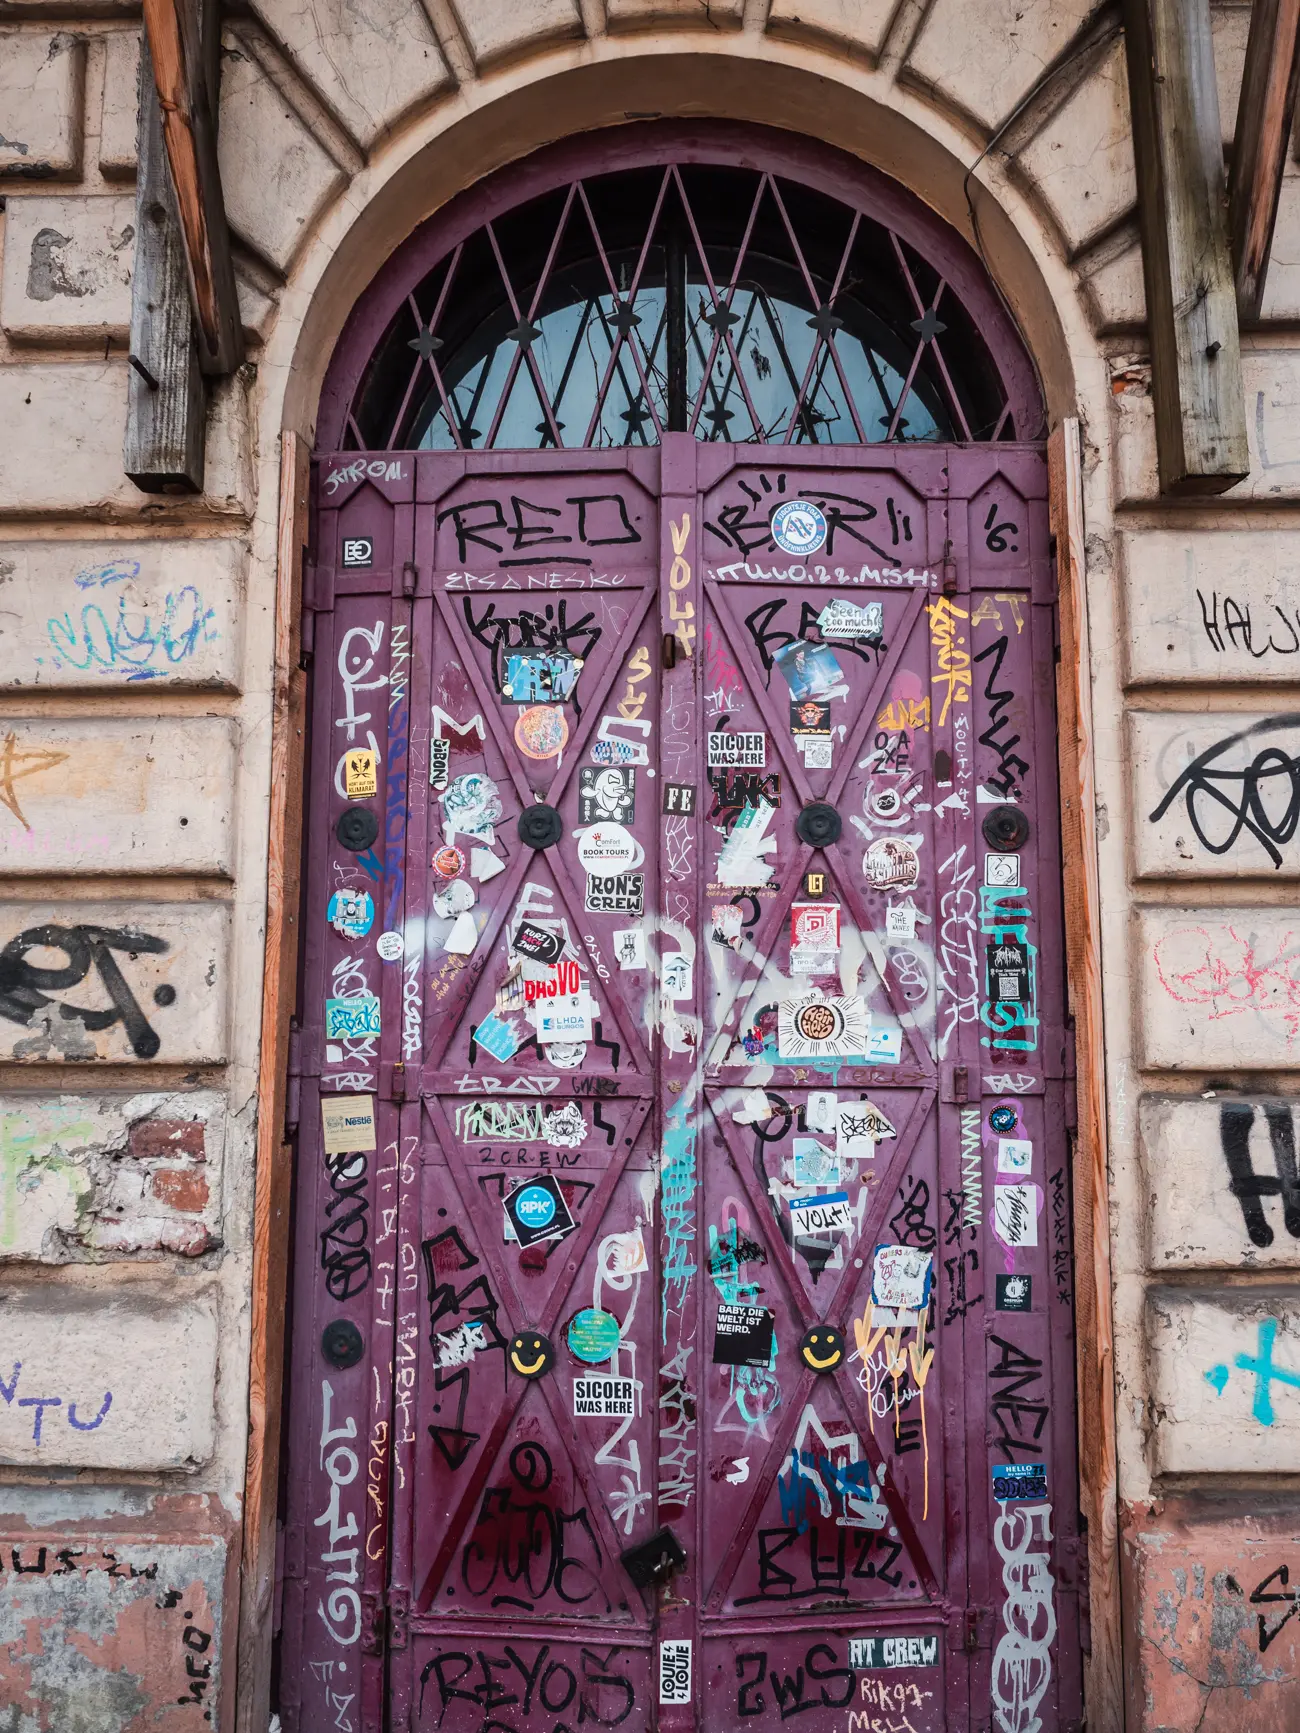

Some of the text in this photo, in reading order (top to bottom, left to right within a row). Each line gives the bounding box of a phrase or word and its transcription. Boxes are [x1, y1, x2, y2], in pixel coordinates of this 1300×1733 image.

[588, 895, 642, 911] CREW
[805, 1006, 834, 1024] Hair
[803, 1021, 834, 1039] Hero
[718, 1305, 764, 1317] BABY, DIE
[717, 1314, 762, 1326] WELT IST
[716, 1323, 751, 1334] WEIRD.
[575, 1400, 633, 1414] WAS HERE
[1005, 1465, 1033, 1473] HELLO
